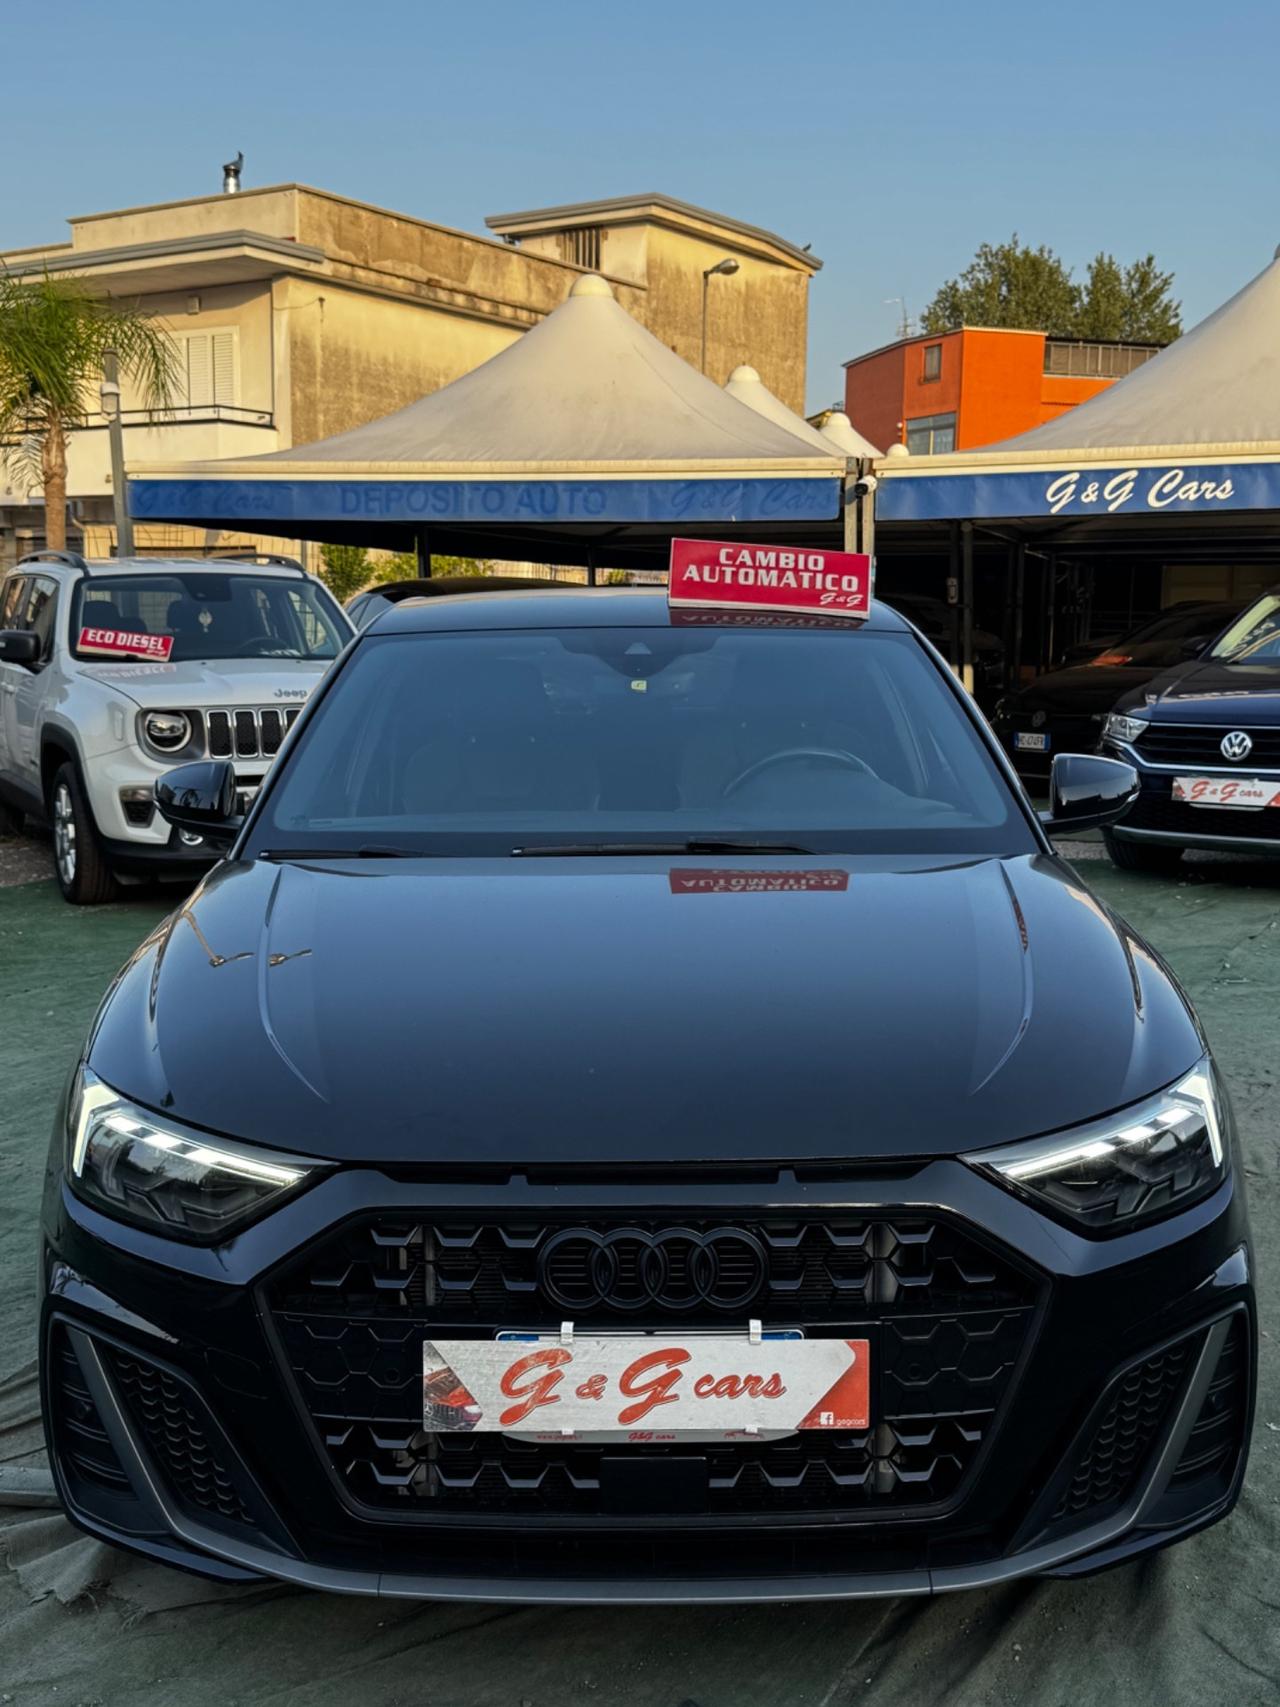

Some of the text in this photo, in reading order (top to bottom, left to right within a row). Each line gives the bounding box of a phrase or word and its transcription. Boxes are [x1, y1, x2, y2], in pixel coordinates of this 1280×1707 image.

[340, 485, 607, 516] DEPOSITO AUTO
[1147, 468, 1235, 509] Cars
[719, 548, 825, 571] CAMBIO
[682, 564, 859, 593] AUTOMATICO
[87, 629, 165, 651] ECO DIESEL
[273, 687, 308, 699] Jeep
[693, 1372, 787, 1400] cars
